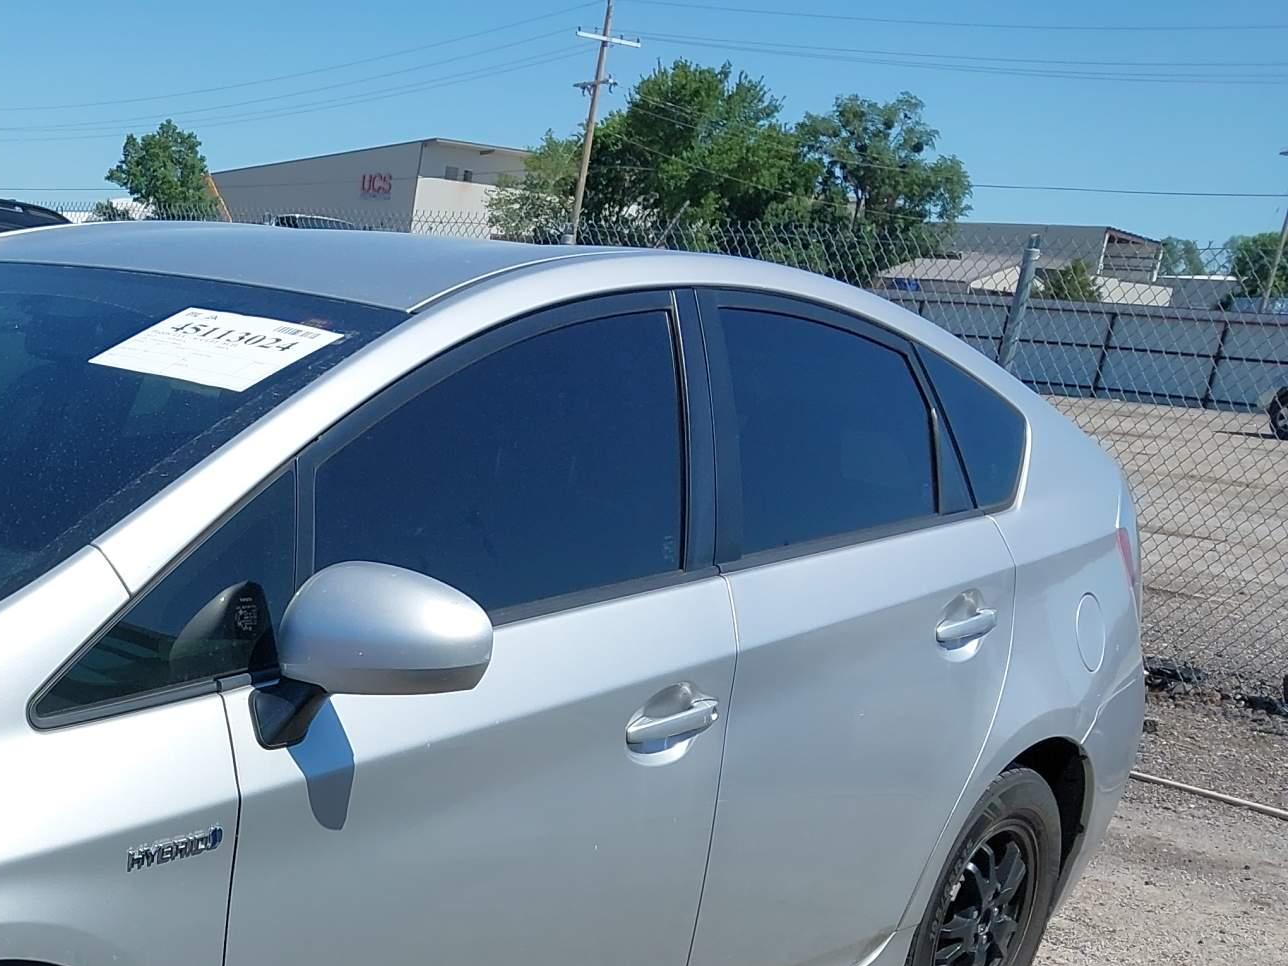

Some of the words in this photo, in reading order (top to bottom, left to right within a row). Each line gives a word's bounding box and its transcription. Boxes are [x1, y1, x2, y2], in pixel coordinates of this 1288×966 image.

[360, 172, 393, 193] UCS
[170, 321, 300, 352] 45113024
[126, 828, 216, 873] HYBRID
